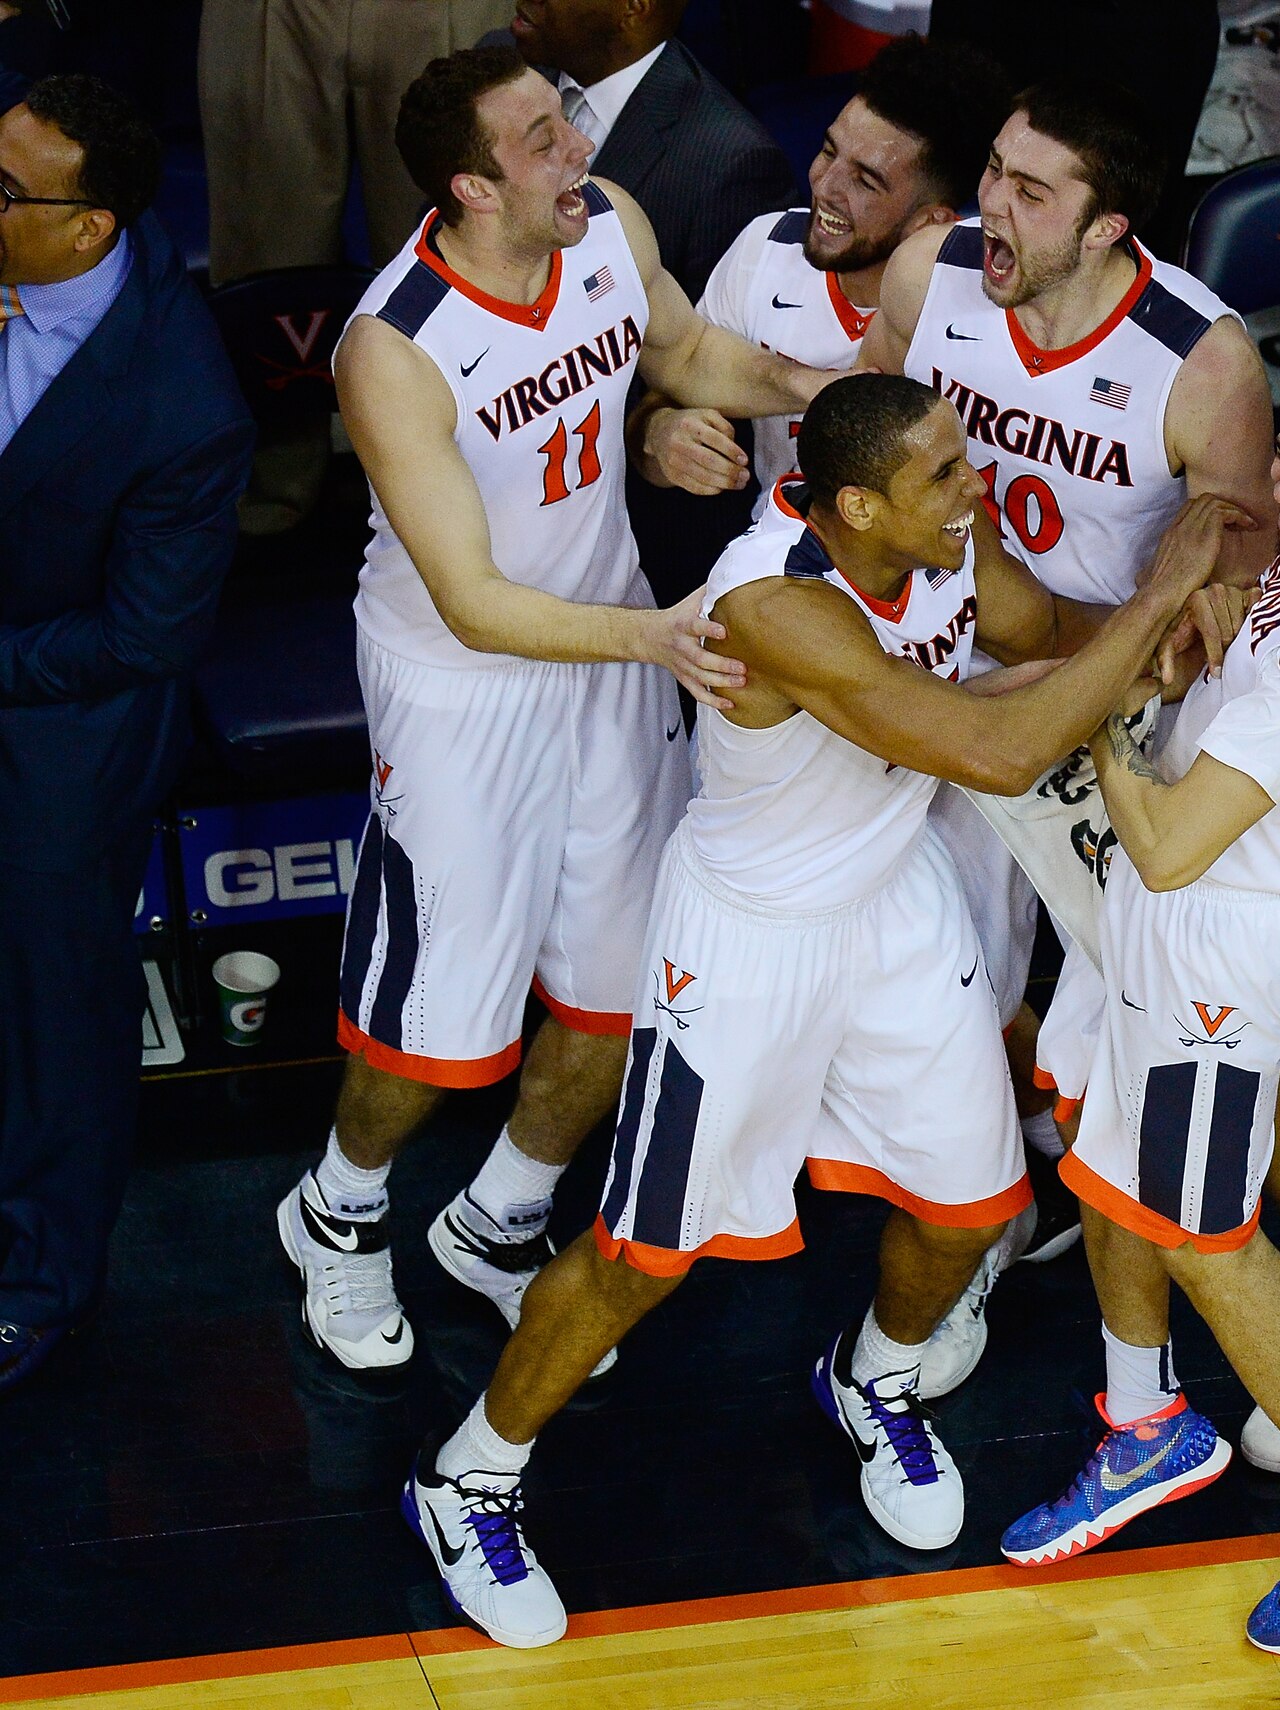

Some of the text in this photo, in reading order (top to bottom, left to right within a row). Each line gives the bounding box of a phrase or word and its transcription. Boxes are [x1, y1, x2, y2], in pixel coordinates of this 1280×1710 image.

[475, 314, 643, 443] VIRGINIA
[537, 398, 603, 507] 11
[204, 838, 354, 908] GEI
[663, 956, 697, 1004] V
[1190, 1000, 1239, 1038] V
